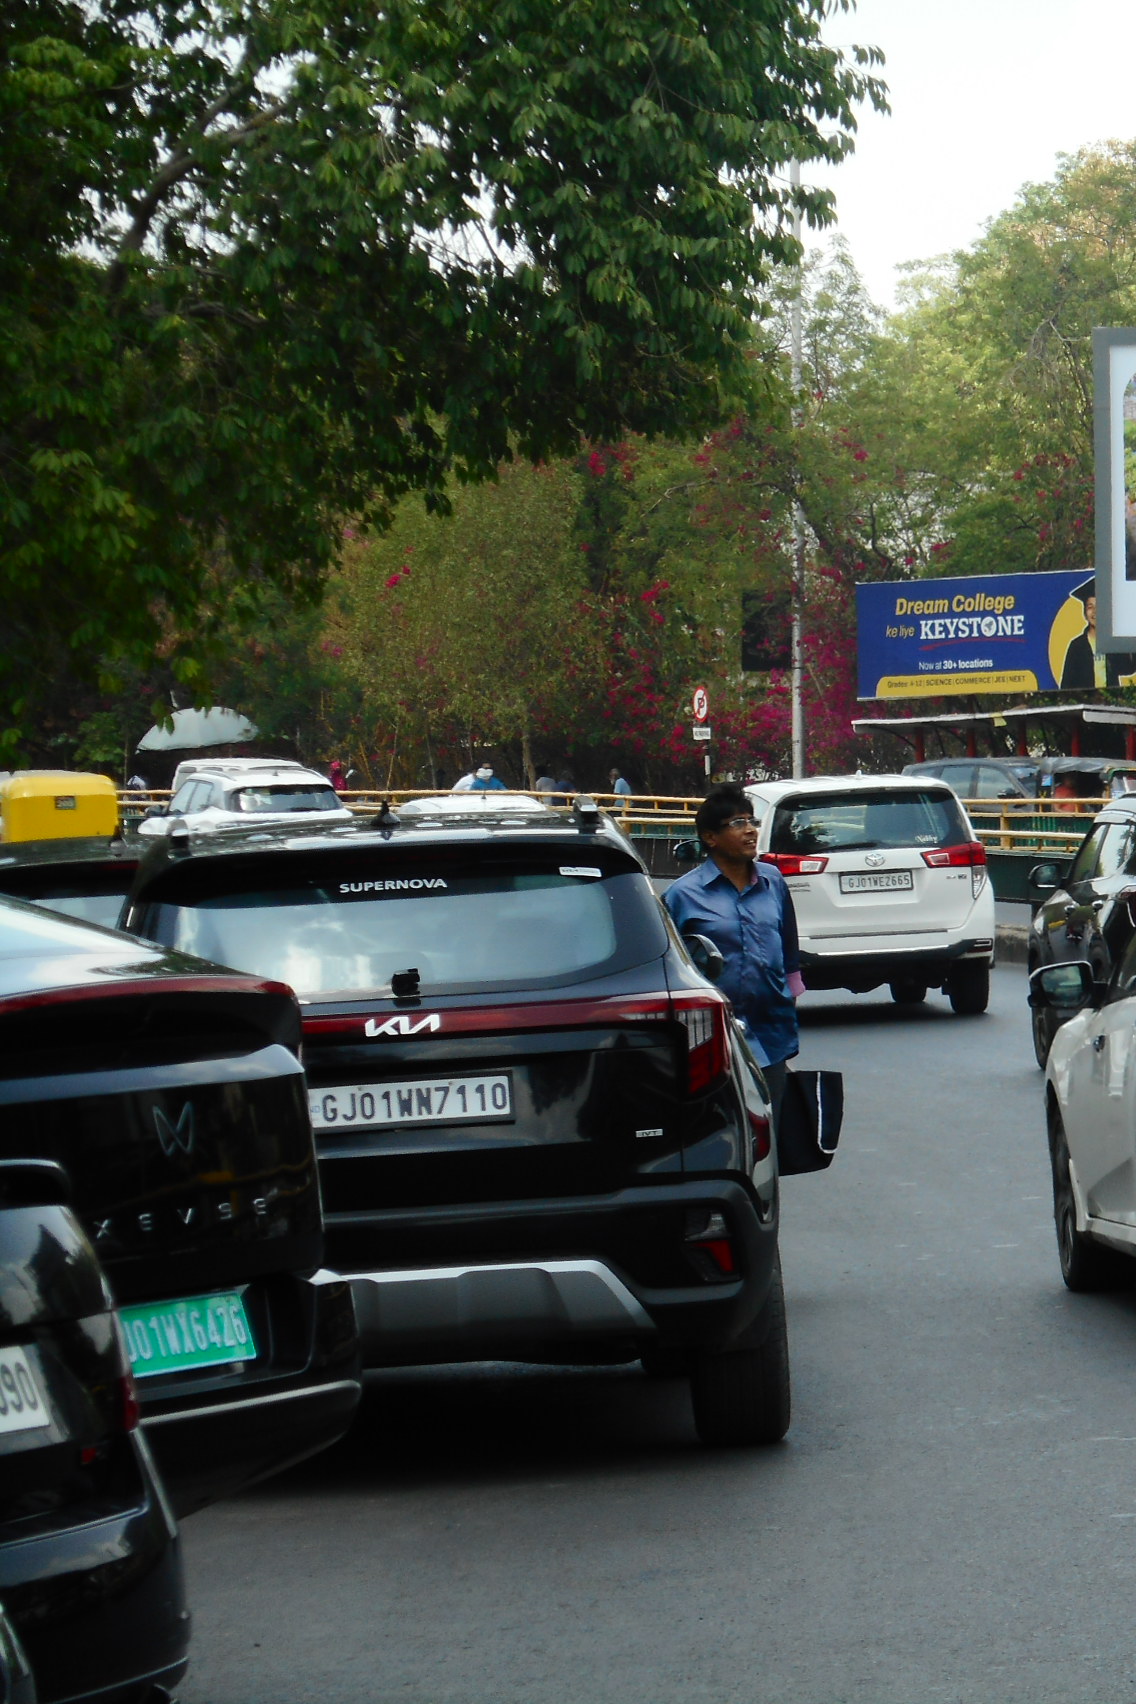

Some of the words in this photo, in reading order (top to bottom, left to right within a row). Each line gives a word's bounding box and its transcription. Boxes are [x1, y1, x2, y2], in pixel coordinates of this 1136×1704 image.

[895, 599, 948, 615] Dream
[952, 593, 1015, 614] College
[886, 626, 897, 638] ke
[920, 615, 1024, 639] KEYSTONE
[919, 662, 934, 670] Now
[935, 661, 942, 669] at
[943, 660, 957, 670] 30+
[958, 659, 993, 669] locations
[955, 677, 991, 685] COMMERCE
[339, 878, 448, 893] SUPERNOVA
[849, 876, 910, 888] GJ01WE2665
[365, 1014, 441, 1037] KIA
[322, 1083, 507, 1122] GJ01WN7110
